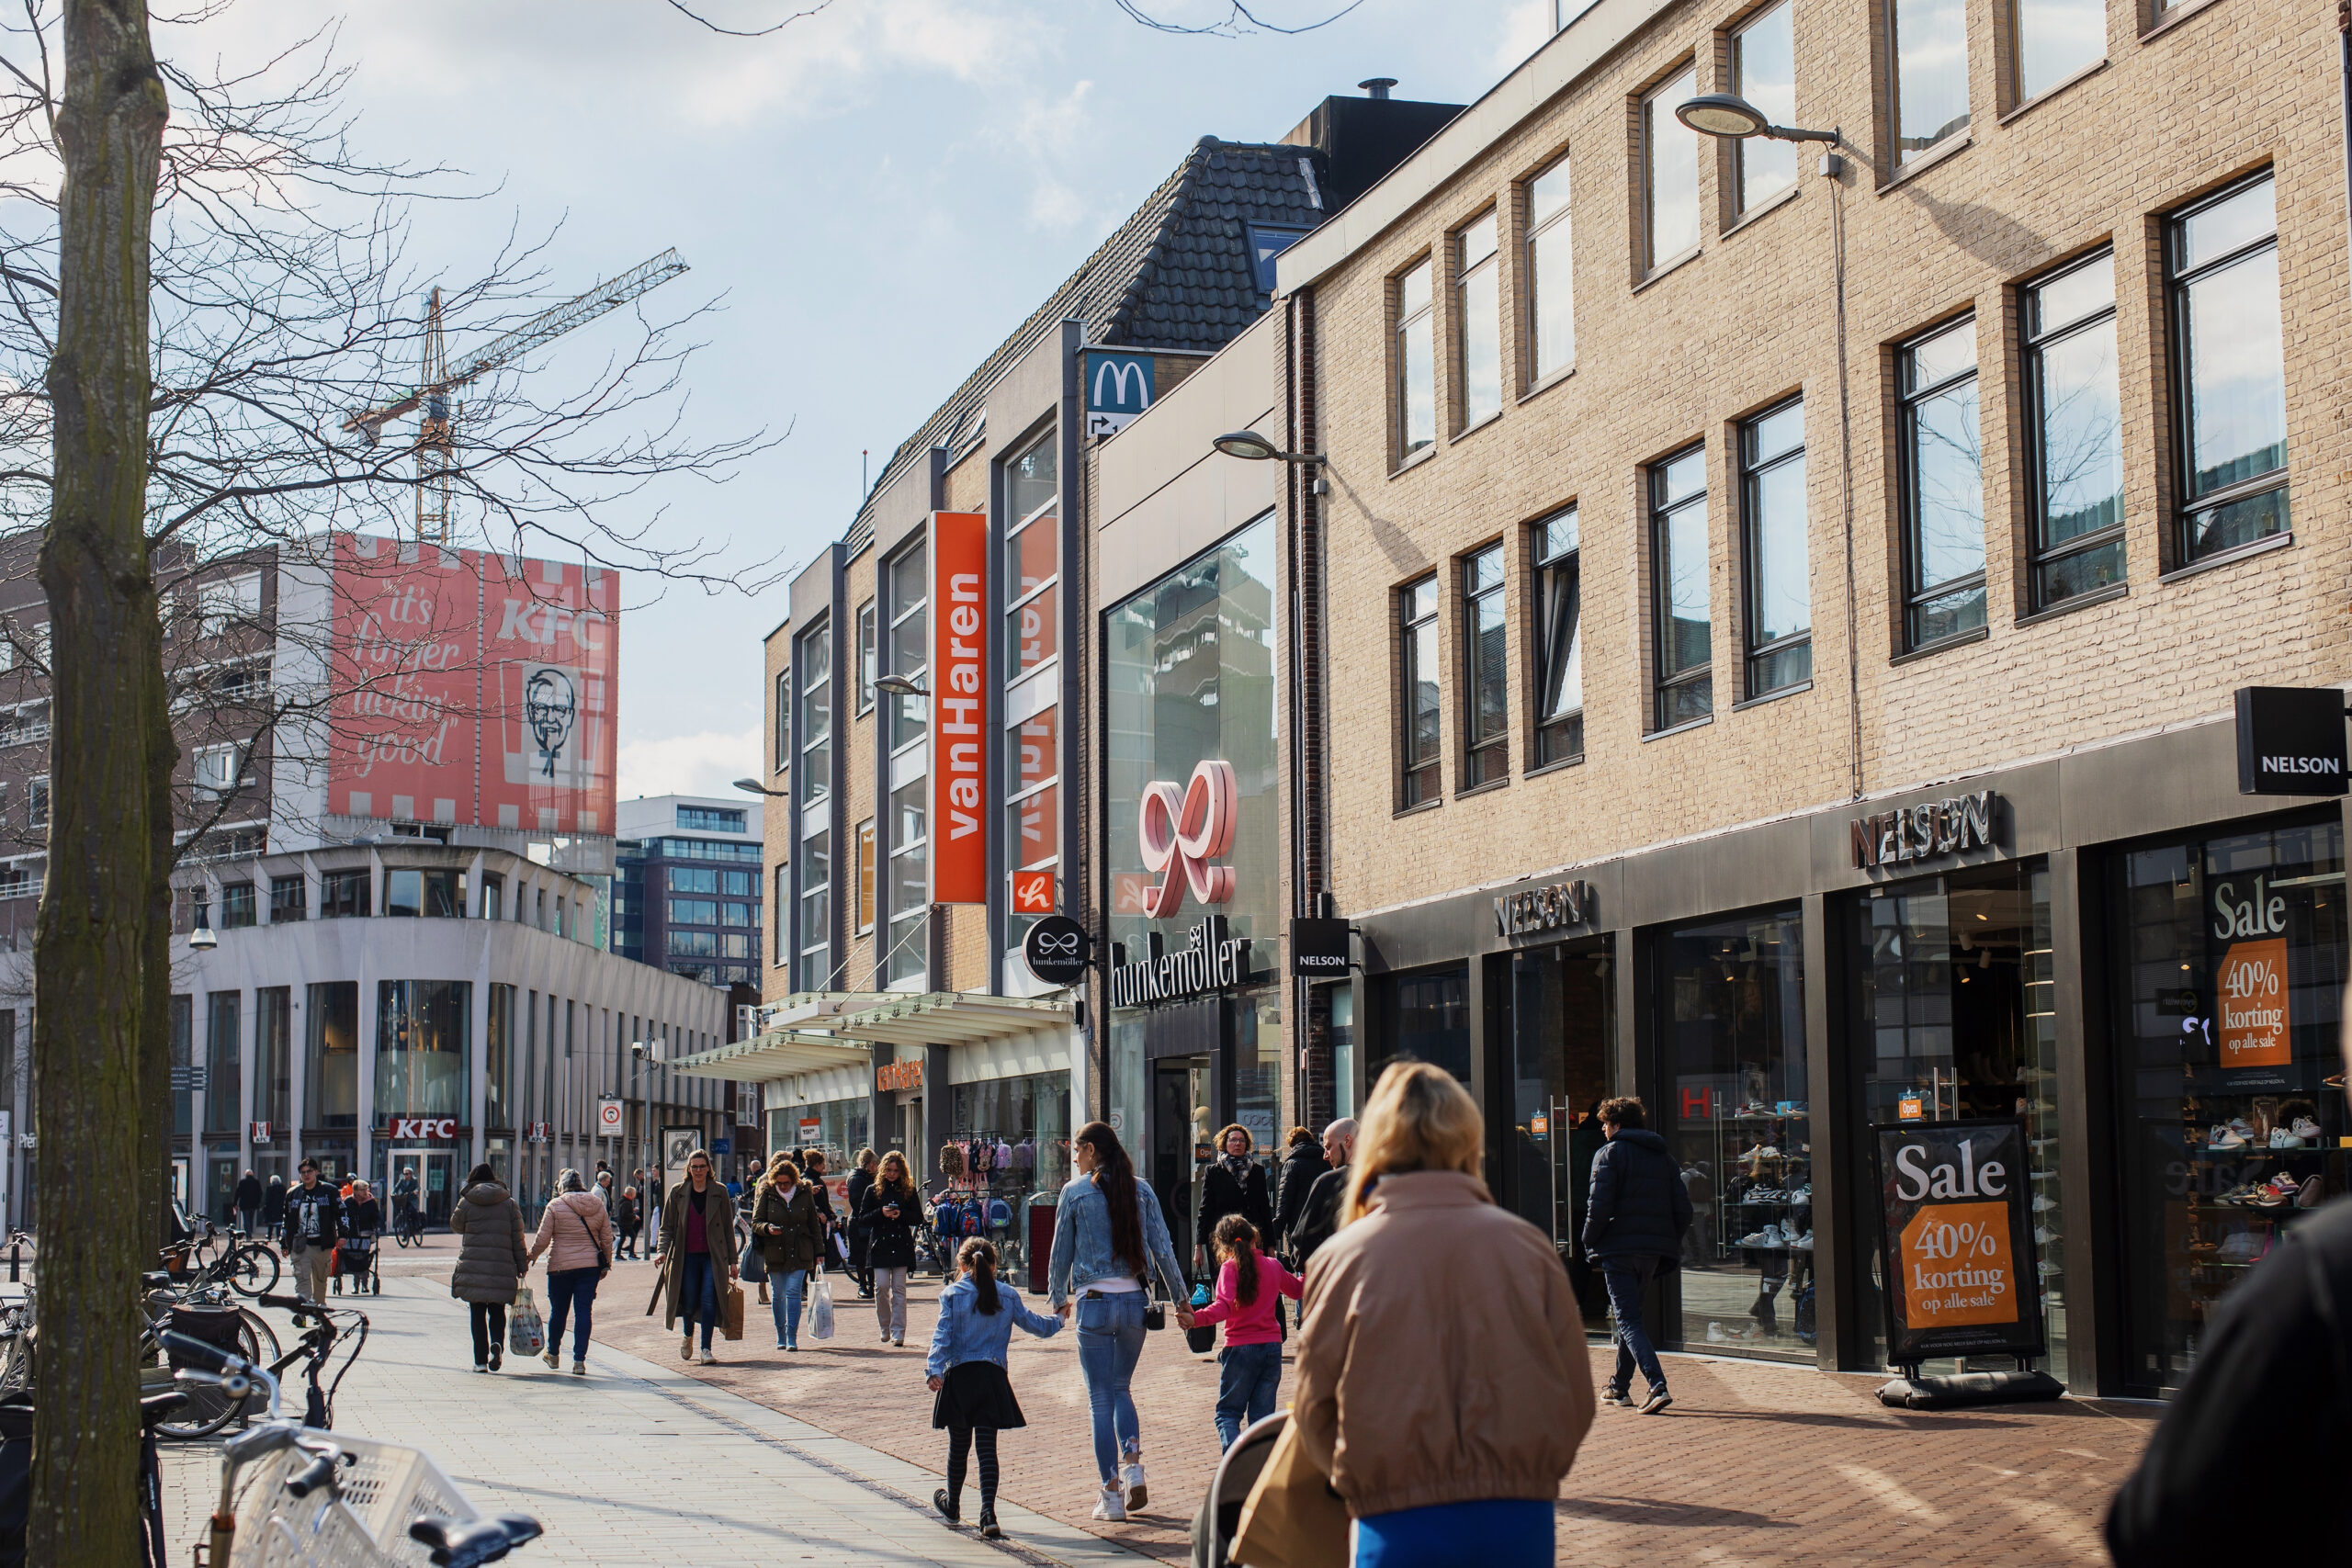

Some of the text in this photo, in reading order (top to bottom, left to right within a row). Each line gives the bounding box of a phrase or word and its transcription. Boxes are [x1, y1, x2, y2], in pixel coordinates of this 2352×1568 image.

[496, 597, 605, 651] KFC
[351, 612, 459, 682] finger
[942, 573, 980, 841] vanHaren
[2262, 755, 2340, 775] NELSON
[1849, 790, 1996, 870] NELSON
[1494, 879, 1587, 938] NELSON
[2214, 874, 2287, 940] Sale
[1032, 956, 1084, 968] hunkemöller
[1111, 915, 1247, 1008] hunkemöller
[1299, 955, 1345, 967] NELSON
[2224, 959, 2278, 998] 40%
[2229, 1031, 2276, 1055] op alle sale
[394, 1119, 455, 1139] KFC
[1903, 1102, 1917, 1117] Open
[1895, 1139, 2007, 1201] Sale
[1914, 1221, 1996, 1259] 40%
[1922, 1292, 1995, 1314] op alle sale
